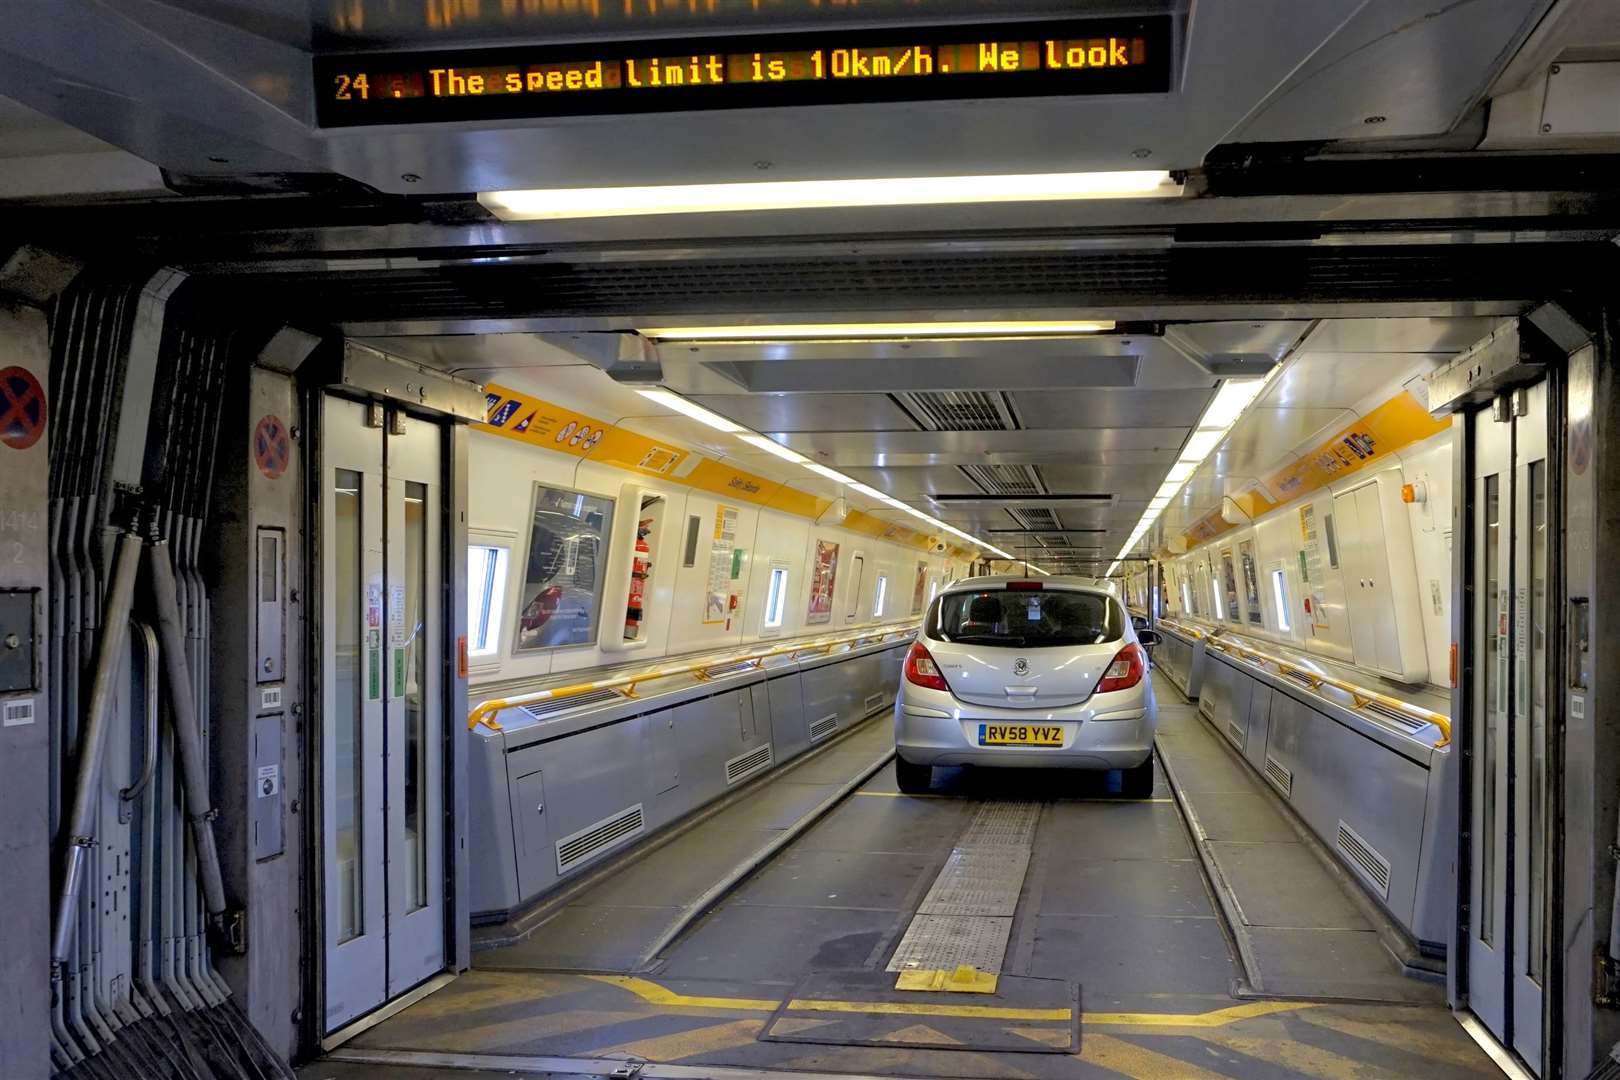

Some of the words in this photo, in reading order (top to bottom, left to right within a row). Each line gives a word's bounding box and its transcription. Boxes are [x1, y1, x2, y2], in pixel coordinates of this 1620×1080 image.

[335, 73, 369, 100] 24
[429, 68, 485, 96] The
[505, 61, 603, 92] speed
[626, 55, 723, 87] limit
[752, 53, 786, 81] is
[979, 42, 1019, 71] We
[1045, 38, 1128, 68] look
[988, 726, 1027, 741] RV58
[1032, 727, 1061, 741] YVZ
